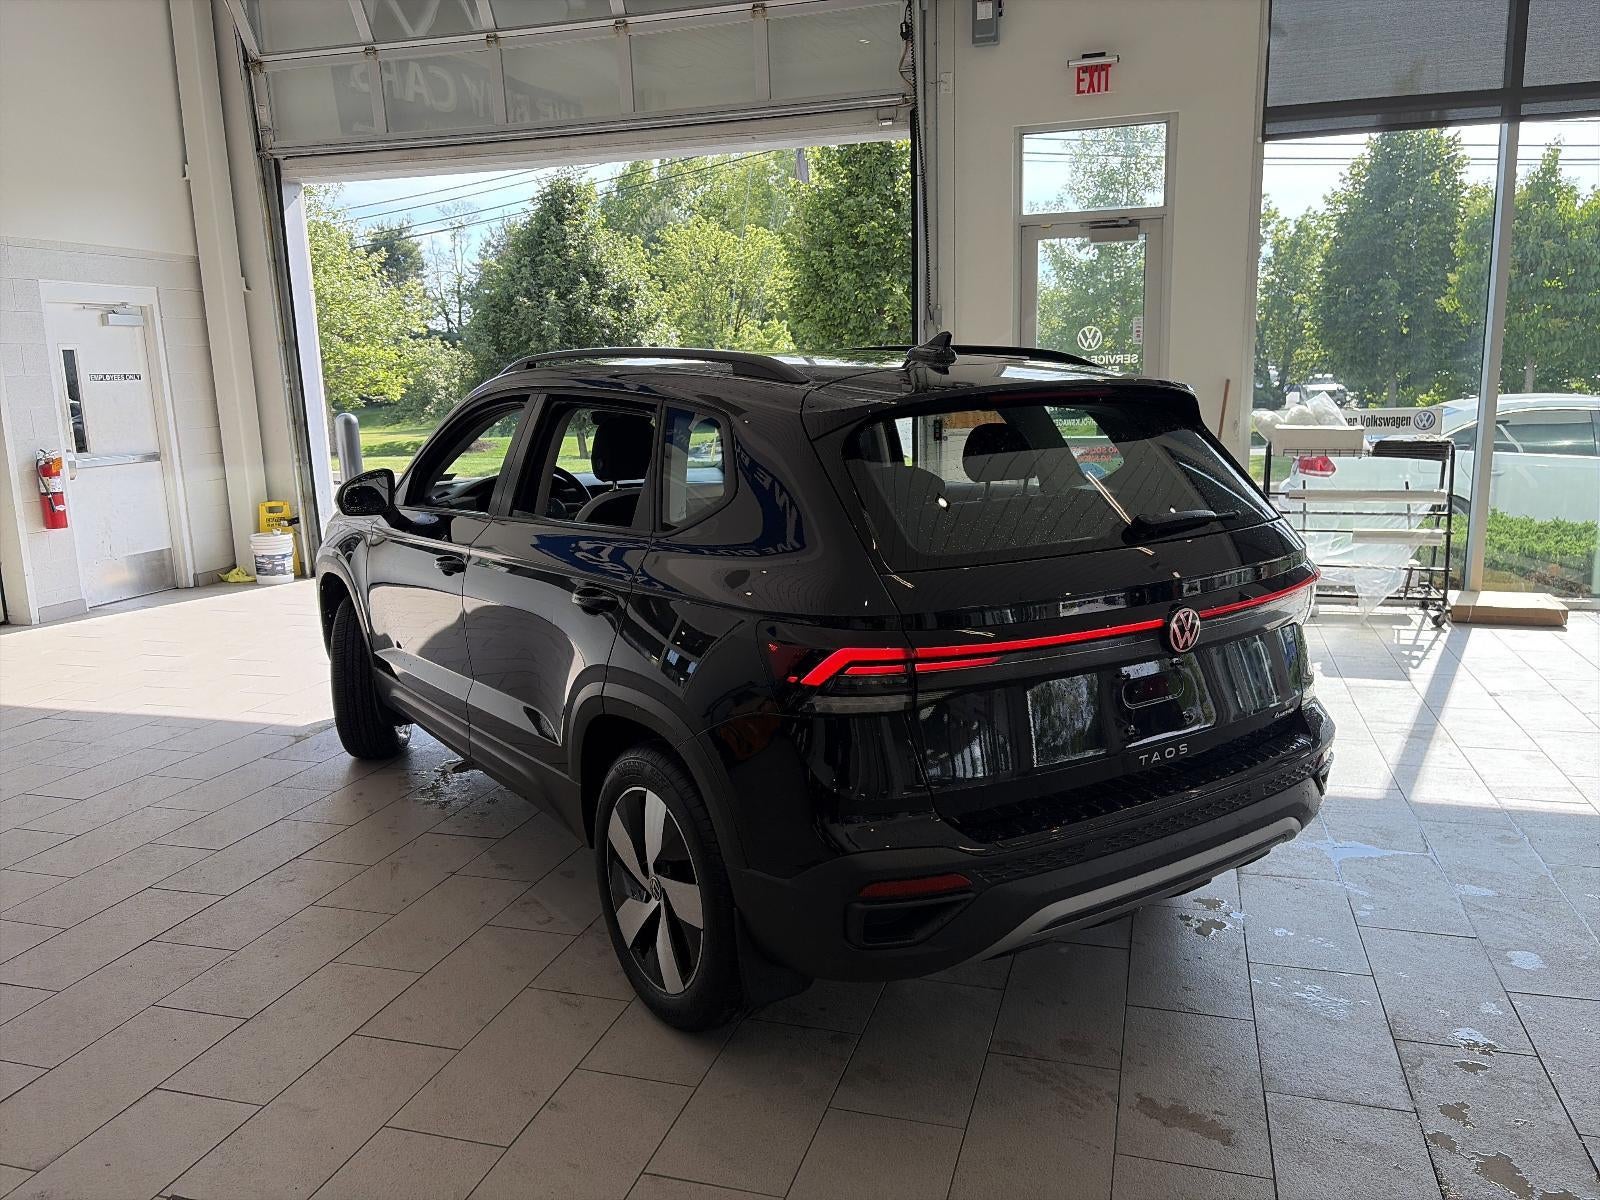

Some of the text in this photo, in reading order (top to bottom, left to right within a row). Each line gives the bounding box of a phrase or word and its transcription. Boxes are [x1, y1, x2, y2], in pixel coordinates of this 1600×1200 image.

[1076, 64, 1111, 94] EXIT
[1360, 414, 1412, 428] Volkswagen
[1139, 744, 1188, 765] TAOS
